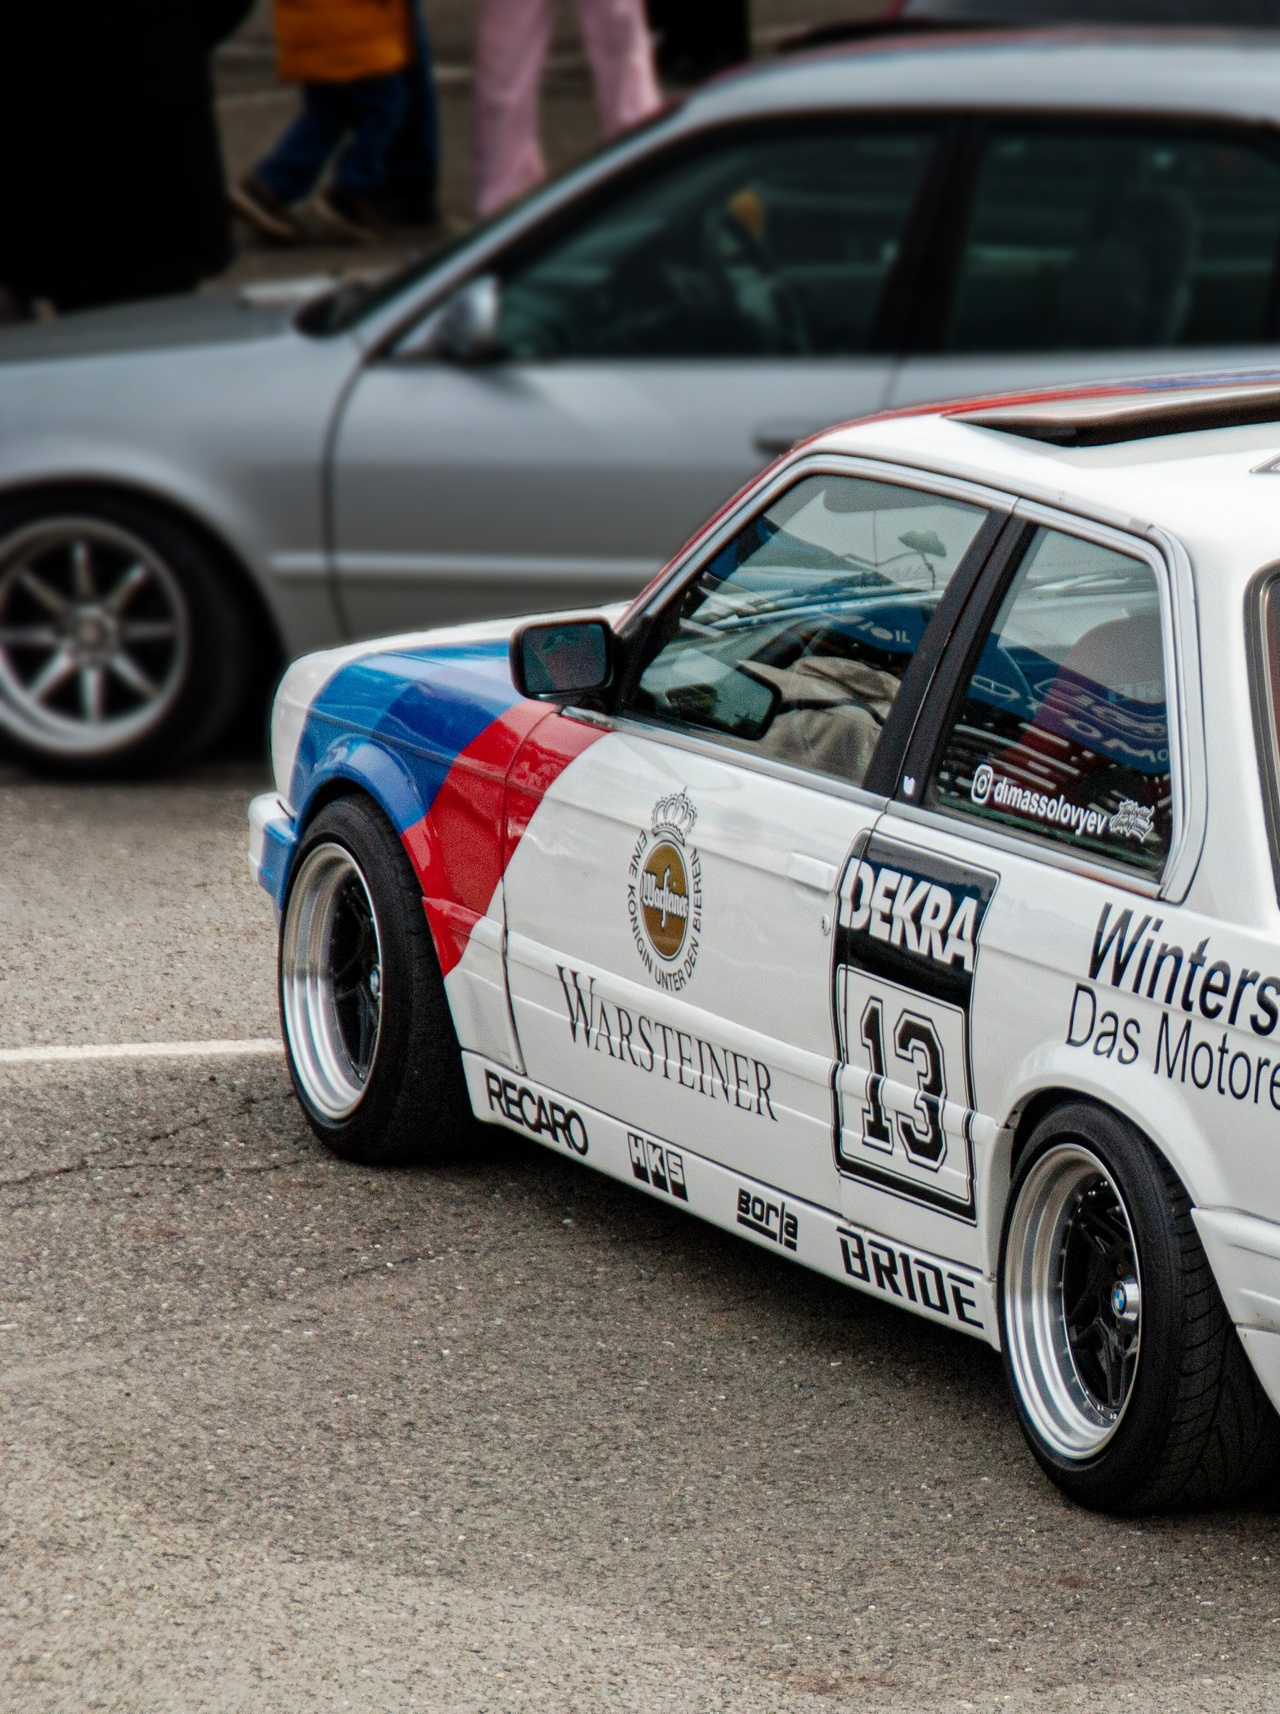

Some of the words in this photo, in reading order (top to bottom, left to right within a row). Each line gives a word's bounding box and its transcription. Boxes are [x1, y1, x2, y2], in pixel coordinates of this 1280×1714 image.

[993, 777, 1108, 835] dimassolovyev
[628, 829, 648, 879] EINE
[690, 848, 703, 934] BIEREN
[627, 884, 652, 974] KÖNIGIN
[684, 936, 700, 979] DEN
[838, 857, 978, 974] DEKRA
[654, 965, 687, 992] UNTER
[1065, 982, 1141, 1065] Das
[484, 1068, 590, 1156] RECARO
[860, 994, 948, 1173] 13
[627, 1131, 689, 1202] HKS
[836, 1226, 985, 1330] BRIDE
